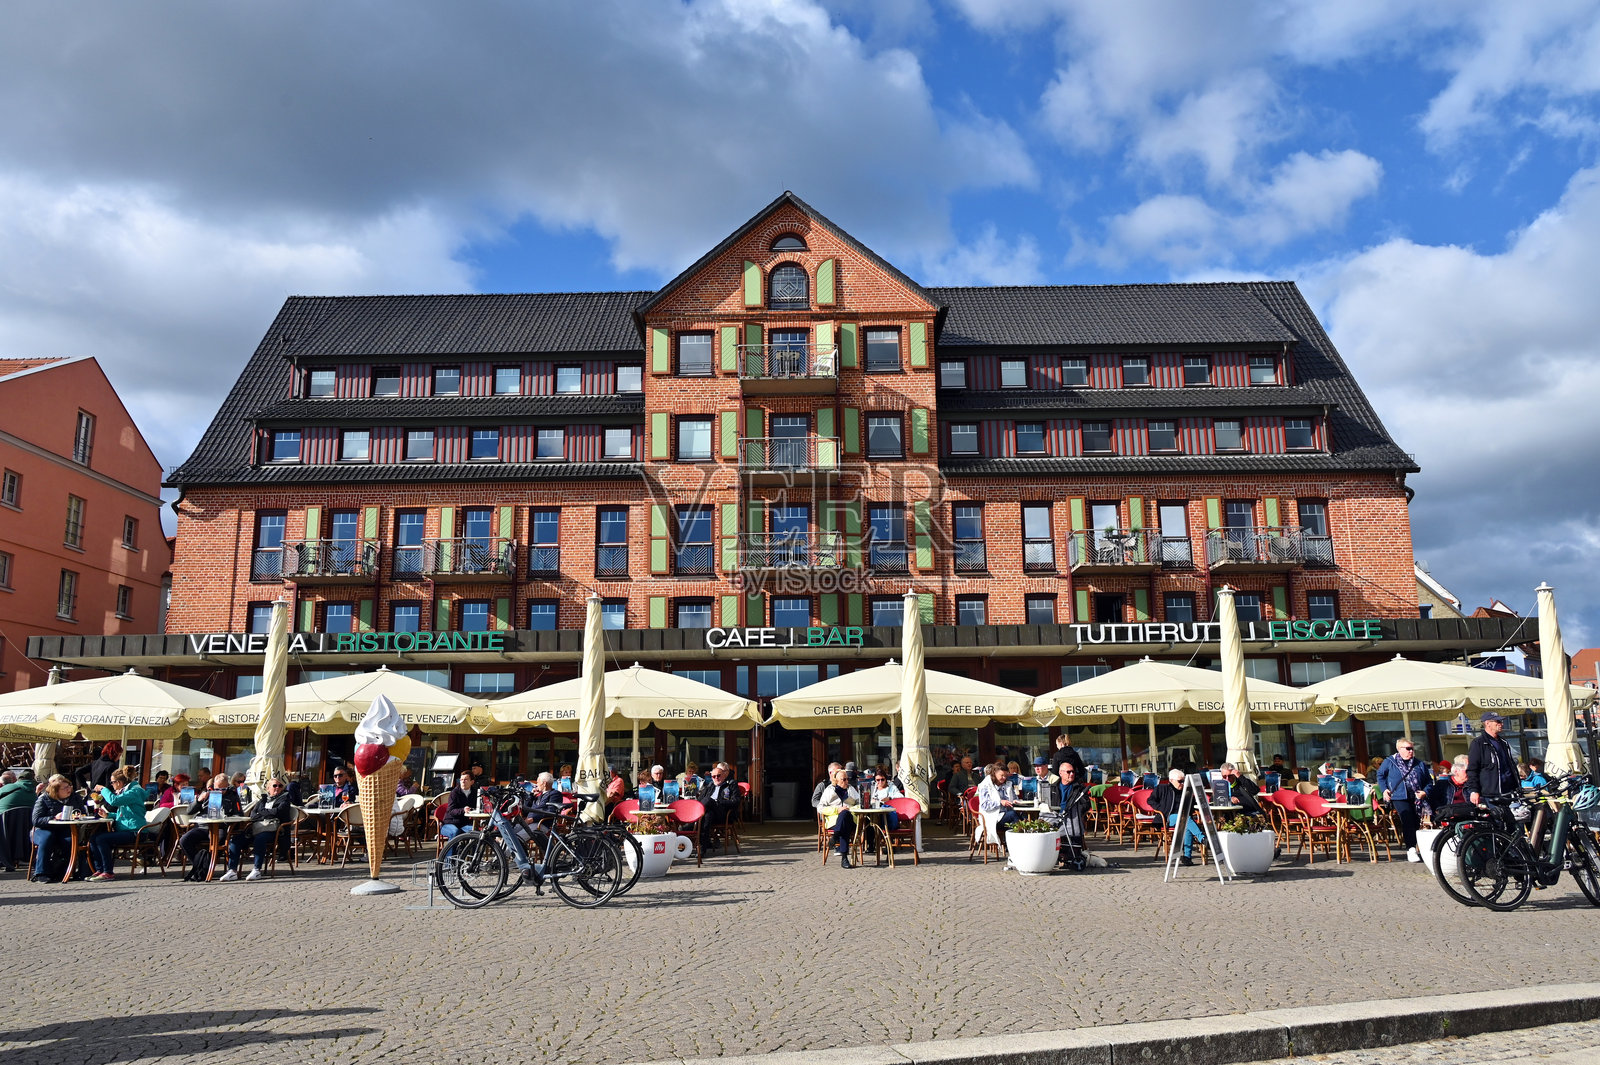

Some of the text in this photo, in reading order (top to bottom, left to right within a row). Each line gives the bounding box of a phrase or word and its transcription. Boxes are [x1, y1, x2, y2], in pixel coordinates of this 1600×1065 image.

[1069, 619, 1383, 643] TUTTIFRUT EISCAFE
[706, 626, 865, 648] CAFE BAR
[189, 631, 504, 654] VENEA RISTORANTE
[1480, 660, 1497, 669] sky
[1066, 704, 1108, 714] EISCAFE
[1111, 703, 1138, 713] TUTTI
[1141, 701, 1176, 711] FRUTTI
[1248, 702, 1271, 711] UTTI
[1273, 702, 1308, 711] FRUTTI
[1347, 699, 1458, 713] EISCAFE TUTTI FRUTTI
[1480, 698, 1522, 707] EISCAFE
[1524, 698, 1545, 707] TUT
[658, 708, 708, 718] CAFE BAR
[813, 705, 863, 715] CAFE BAR
[945, 704, 995, 714] CAFE BAR
[62, 714, 171, 725] RISTORANTE VENEZIA
[218, 713, 326, 723] RISTORA VENEZIA
[415, 714, 458, 724] VENEZIA
[527, 709, 576, 720] CAFE BAR
[654, 843, 666, 852] illy
